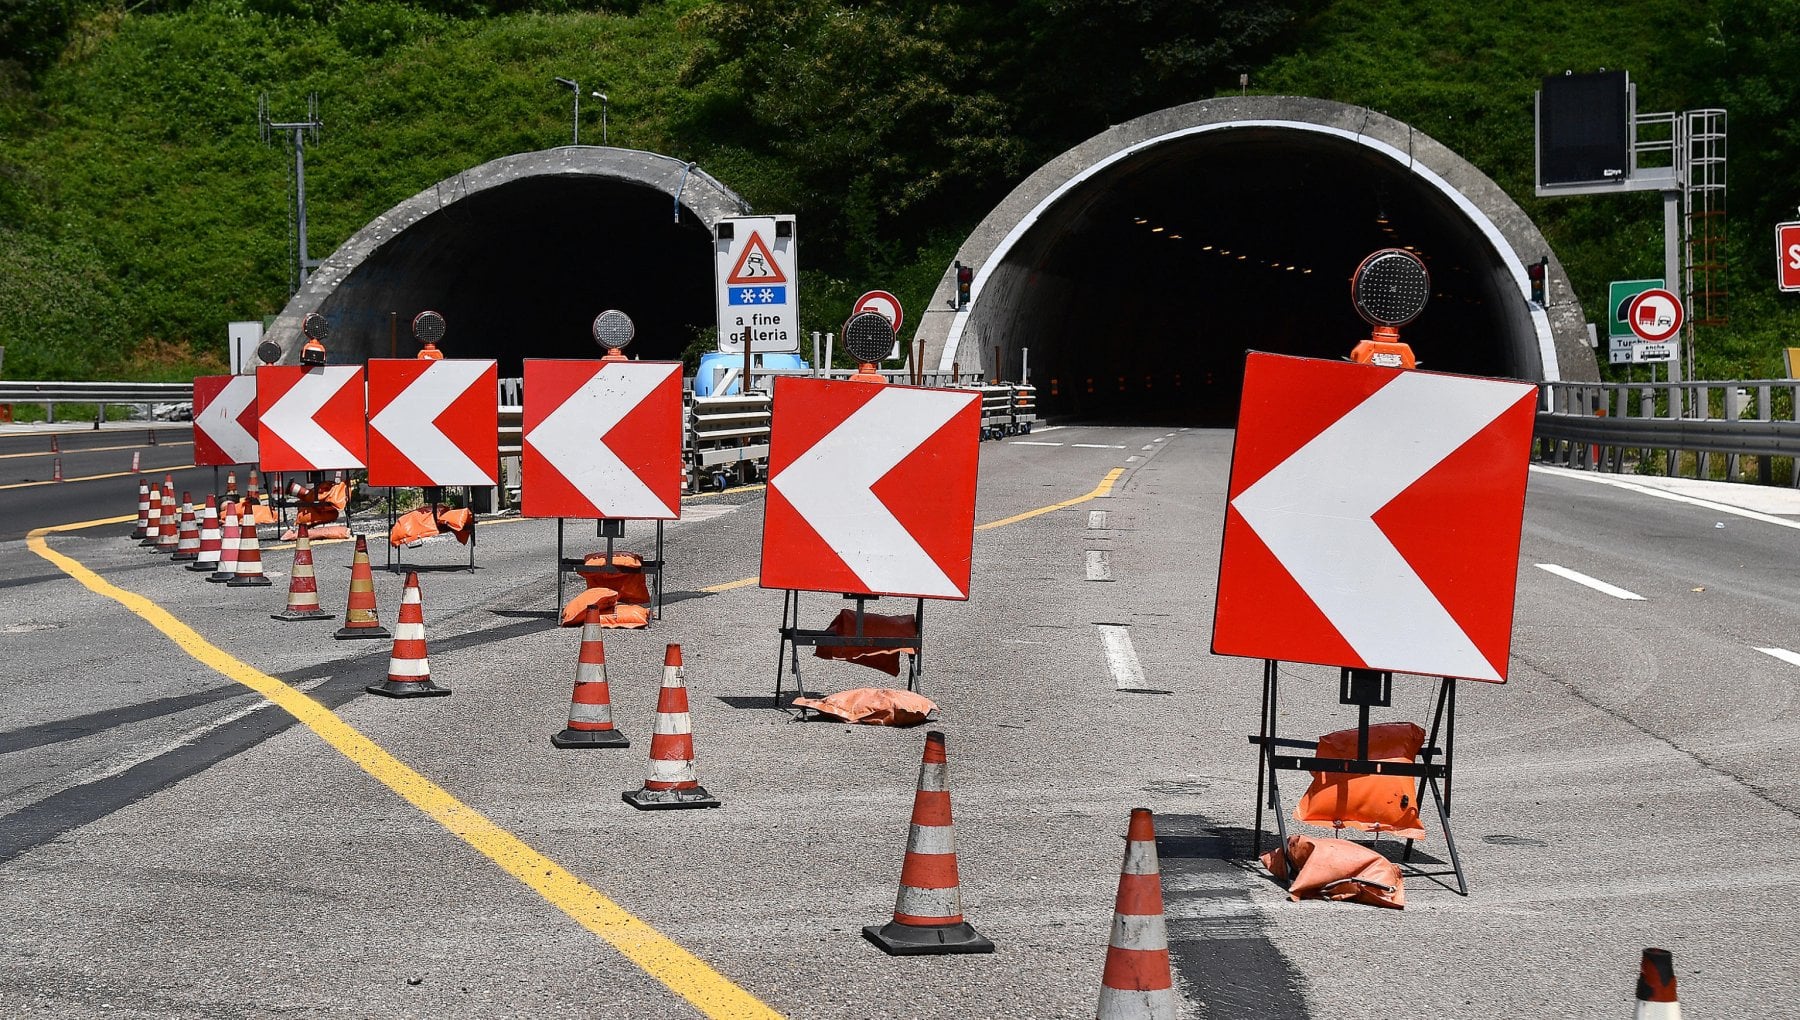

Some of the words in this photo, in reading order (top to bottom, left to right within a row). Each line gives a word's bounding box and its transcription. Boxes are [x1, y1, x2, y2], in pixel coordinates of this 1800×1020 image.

[736, 316, 744, 325] a
[752, 313, 780, 325] fine
[730, 328, 787, 344] galeria
